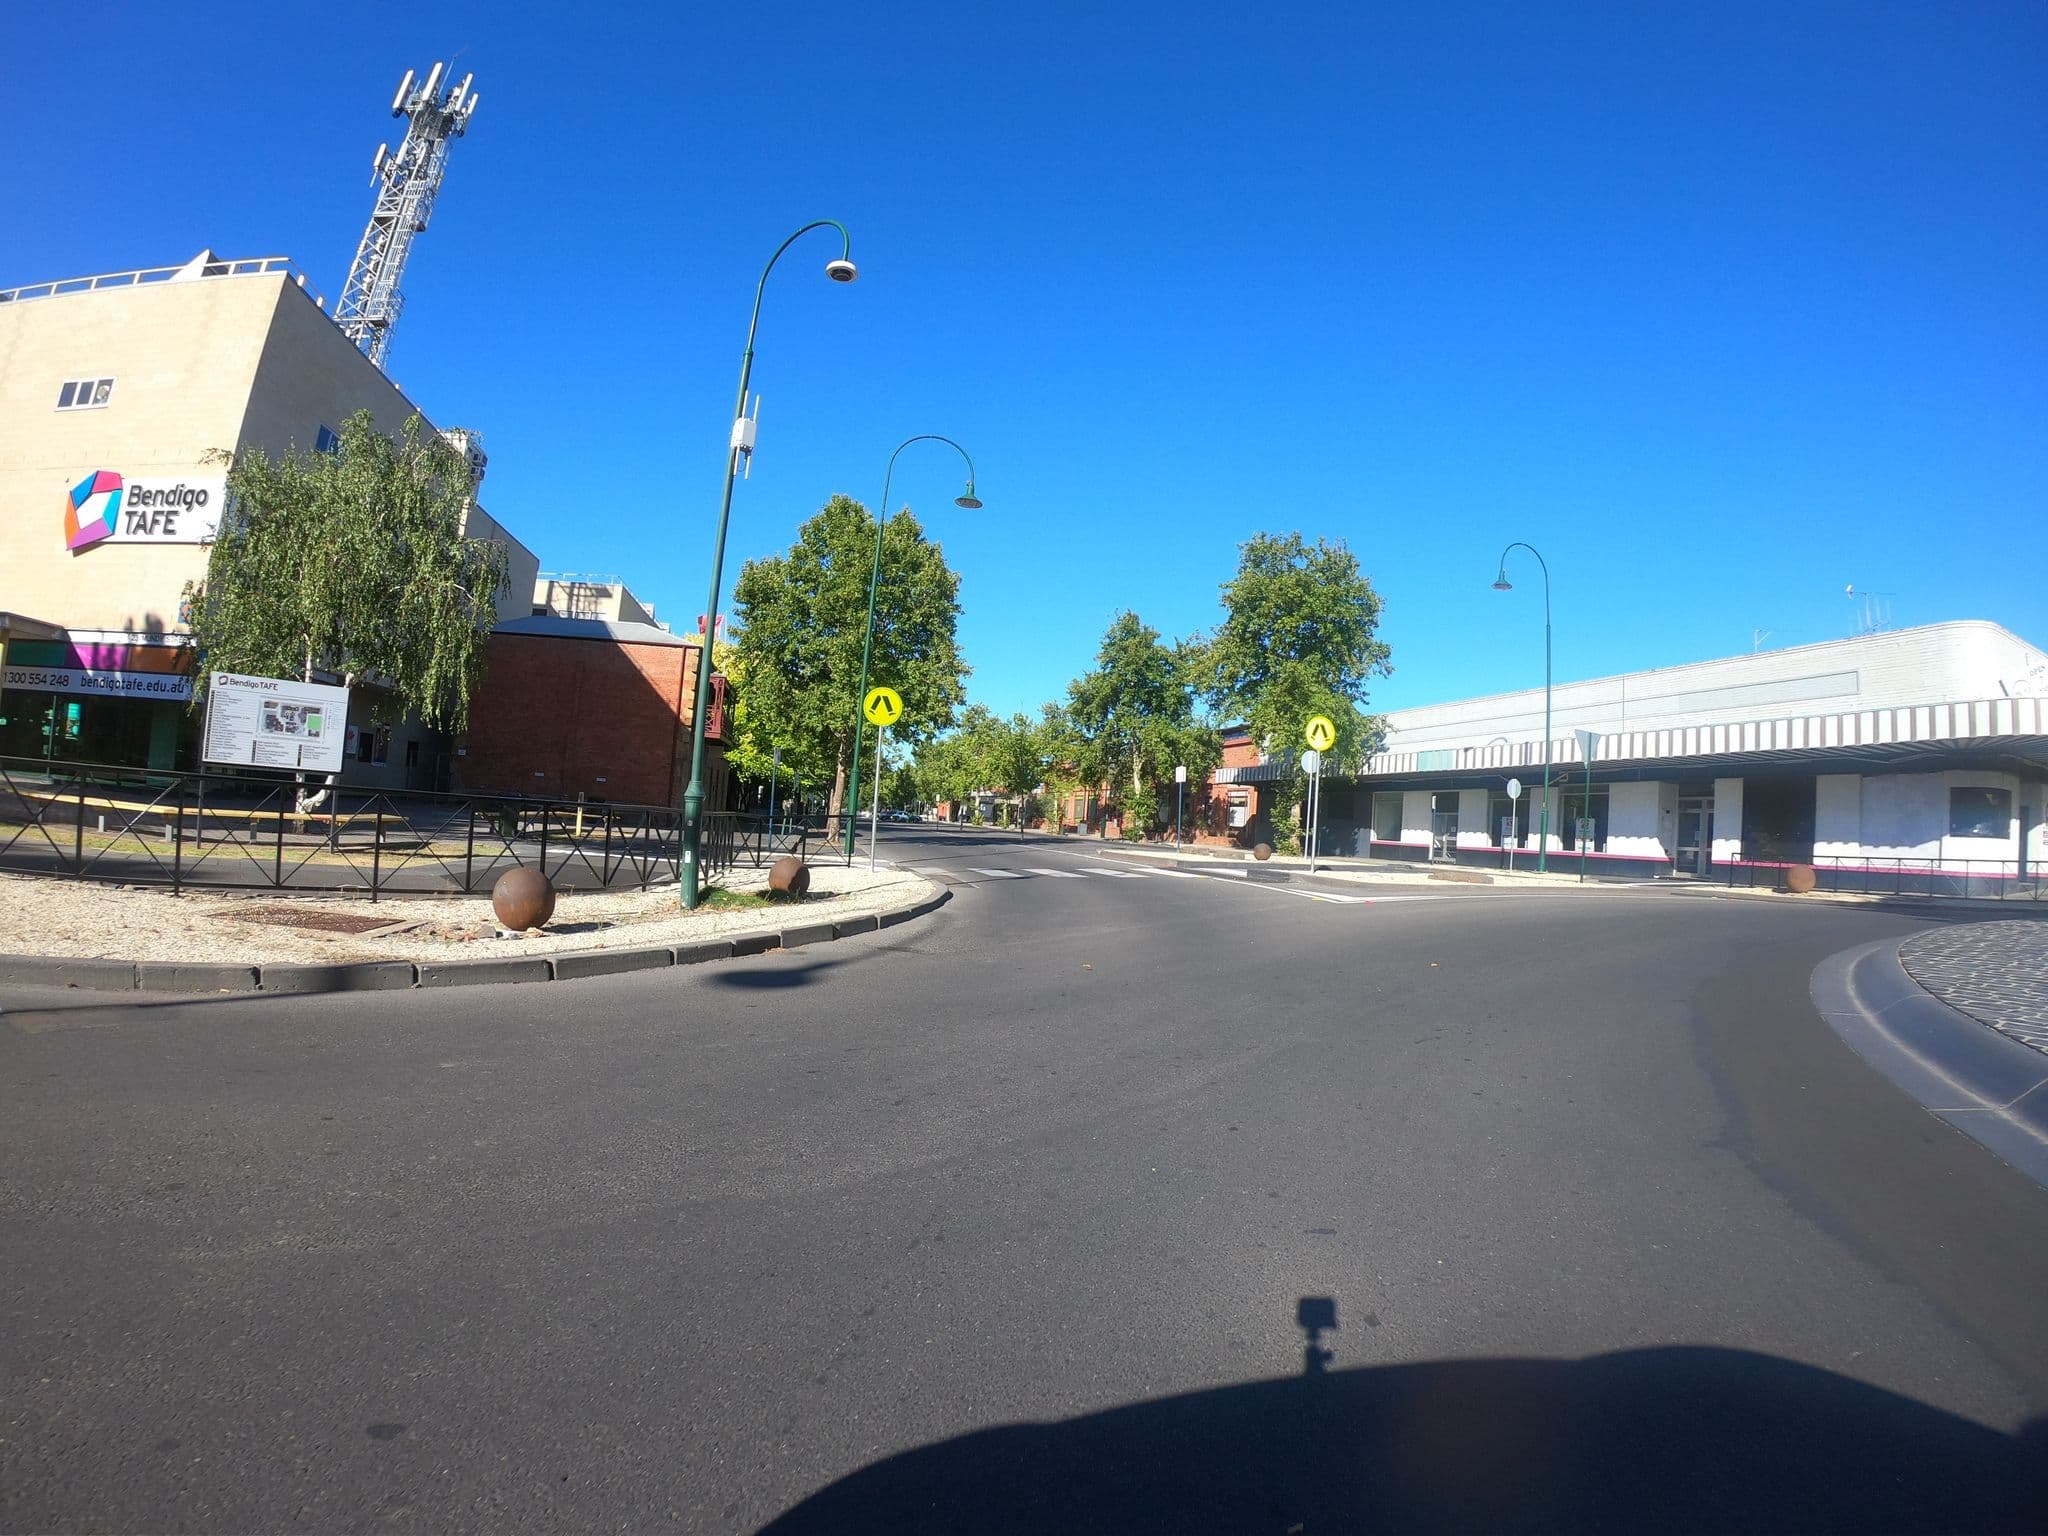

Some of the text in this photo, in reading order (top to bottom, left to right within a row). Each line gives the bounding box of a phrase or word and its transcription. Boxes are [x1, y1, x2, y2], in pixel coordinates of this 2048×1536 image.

[128, 483, 209, 511] Bendigo
[125, 510, 180, 535] TAFE
[4, 672, 184, 693] 1300 554 248 bendigotafe.edu.au
[229, 678, 279, 690] Bendigo TAFE
